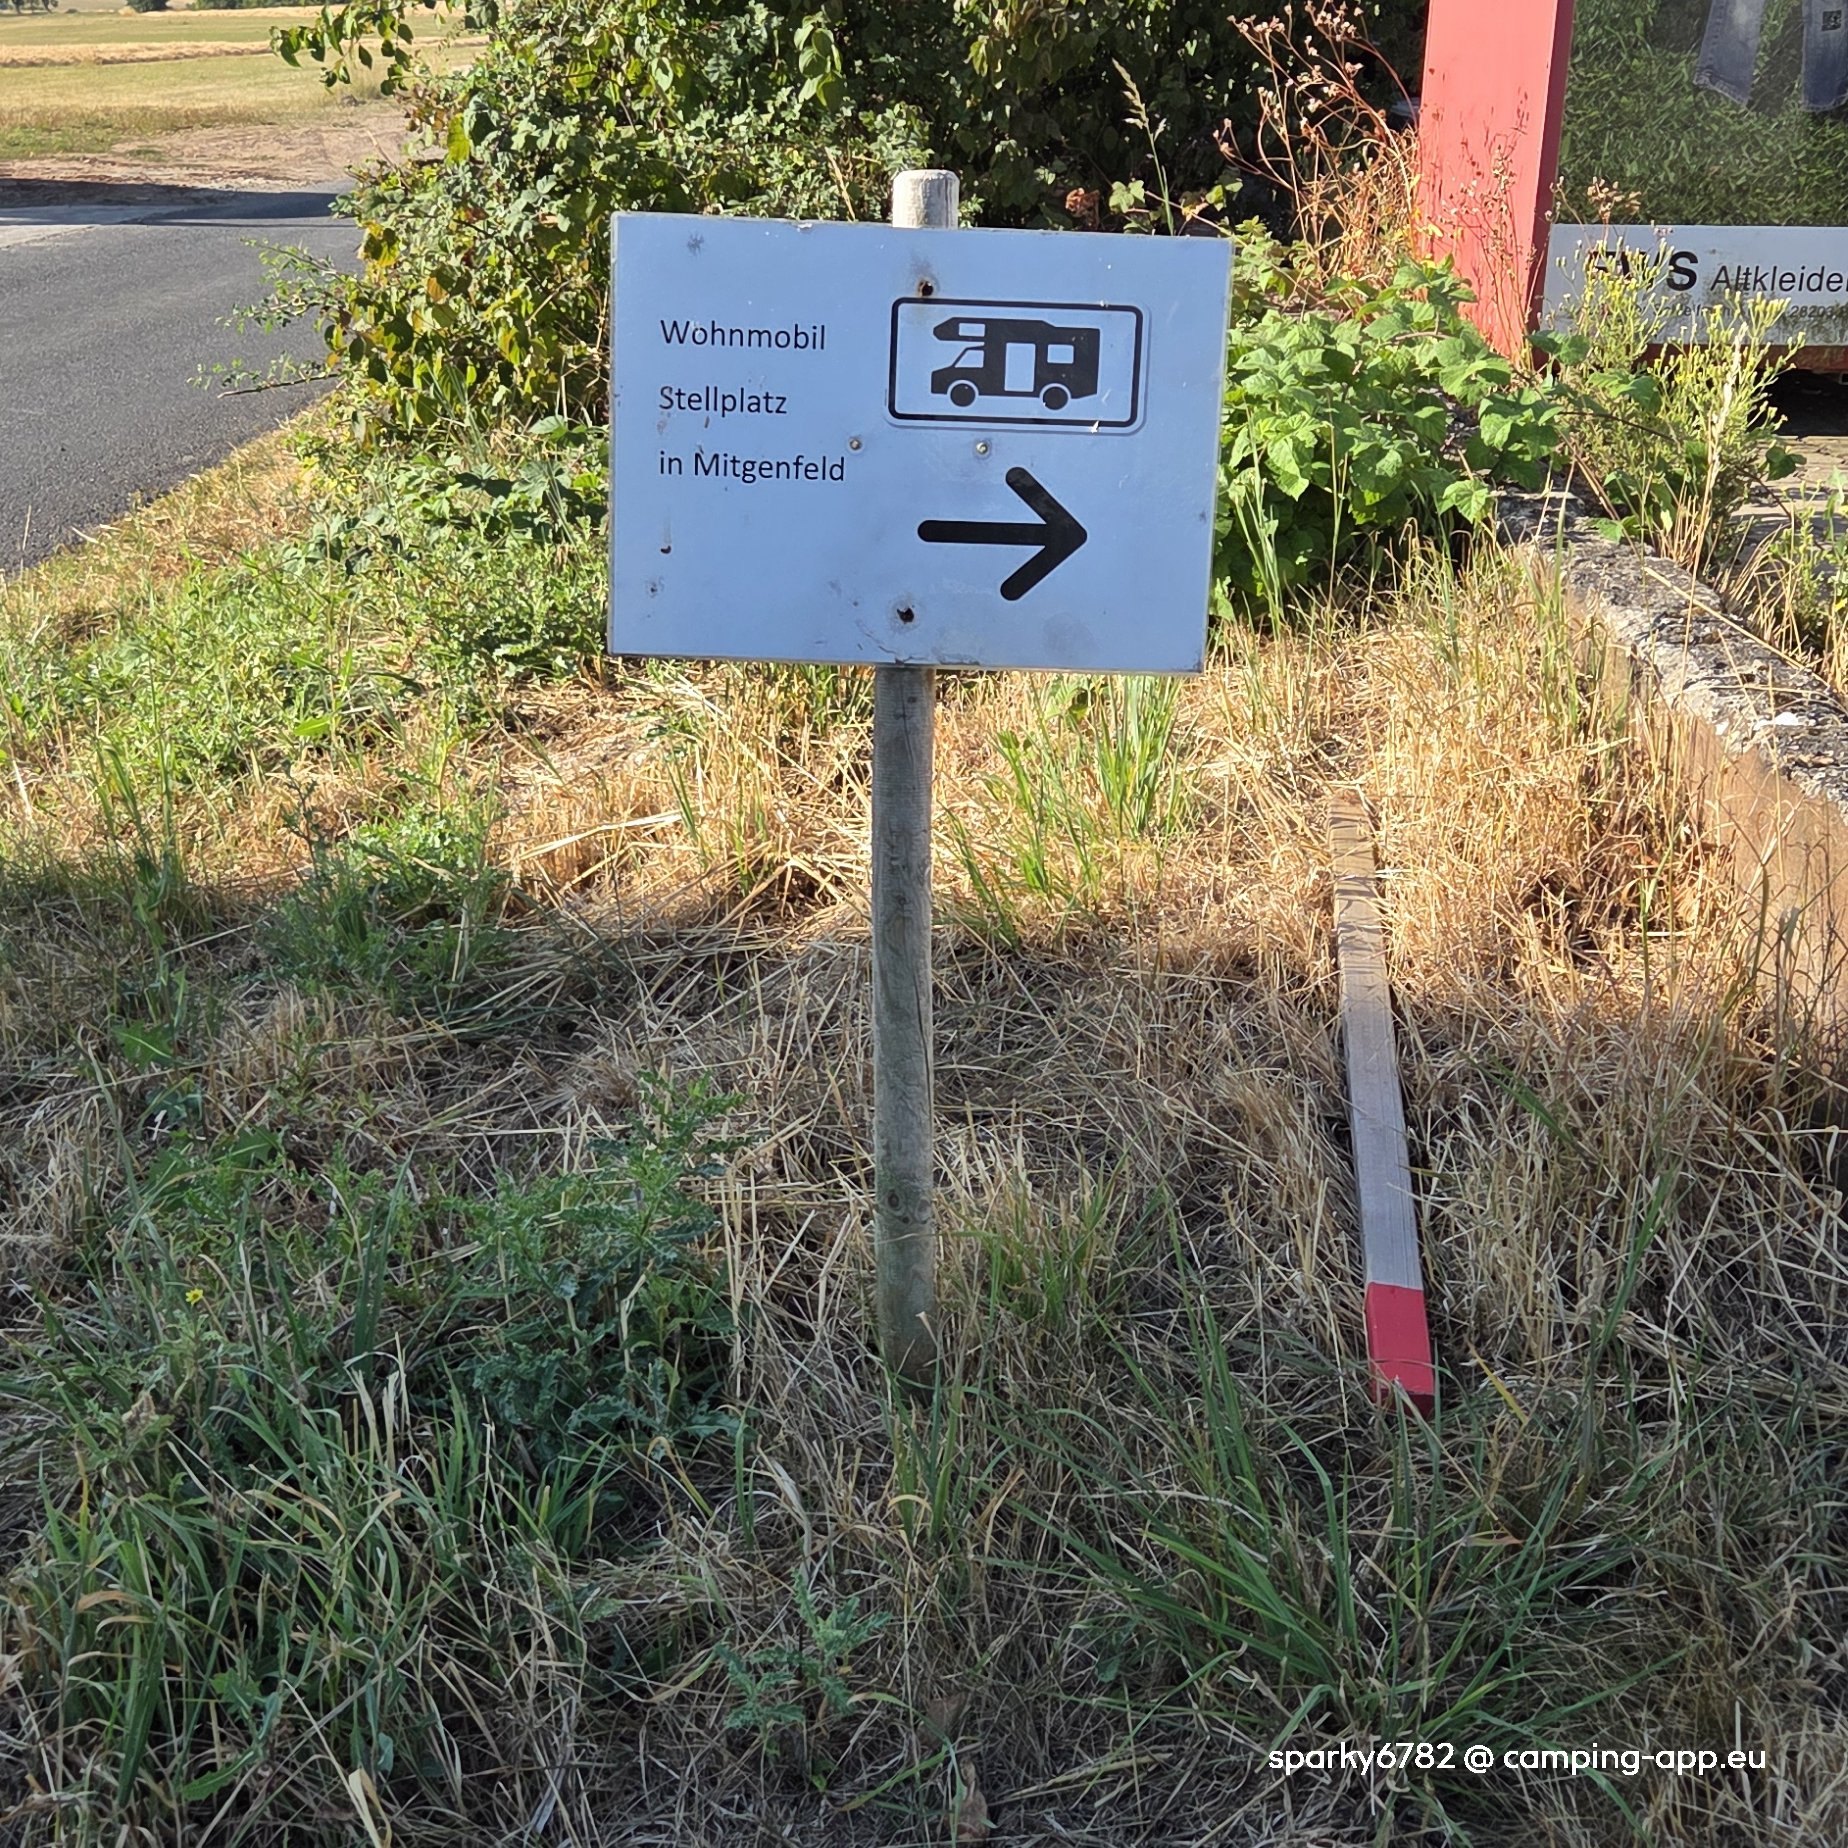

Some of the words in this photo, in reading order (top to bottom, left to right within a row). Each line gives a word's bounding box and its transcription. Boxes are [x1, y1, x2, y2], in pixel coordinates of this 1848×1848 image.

[1709, 265, 1848, 292] Altkleide
[660, 319, 825, 350] Wohnmobil
[659, 385, 787, 418] Stellplatz
[659, 450, 682, 475] in
[694, 452, 845, 484] Mitgenfeld
